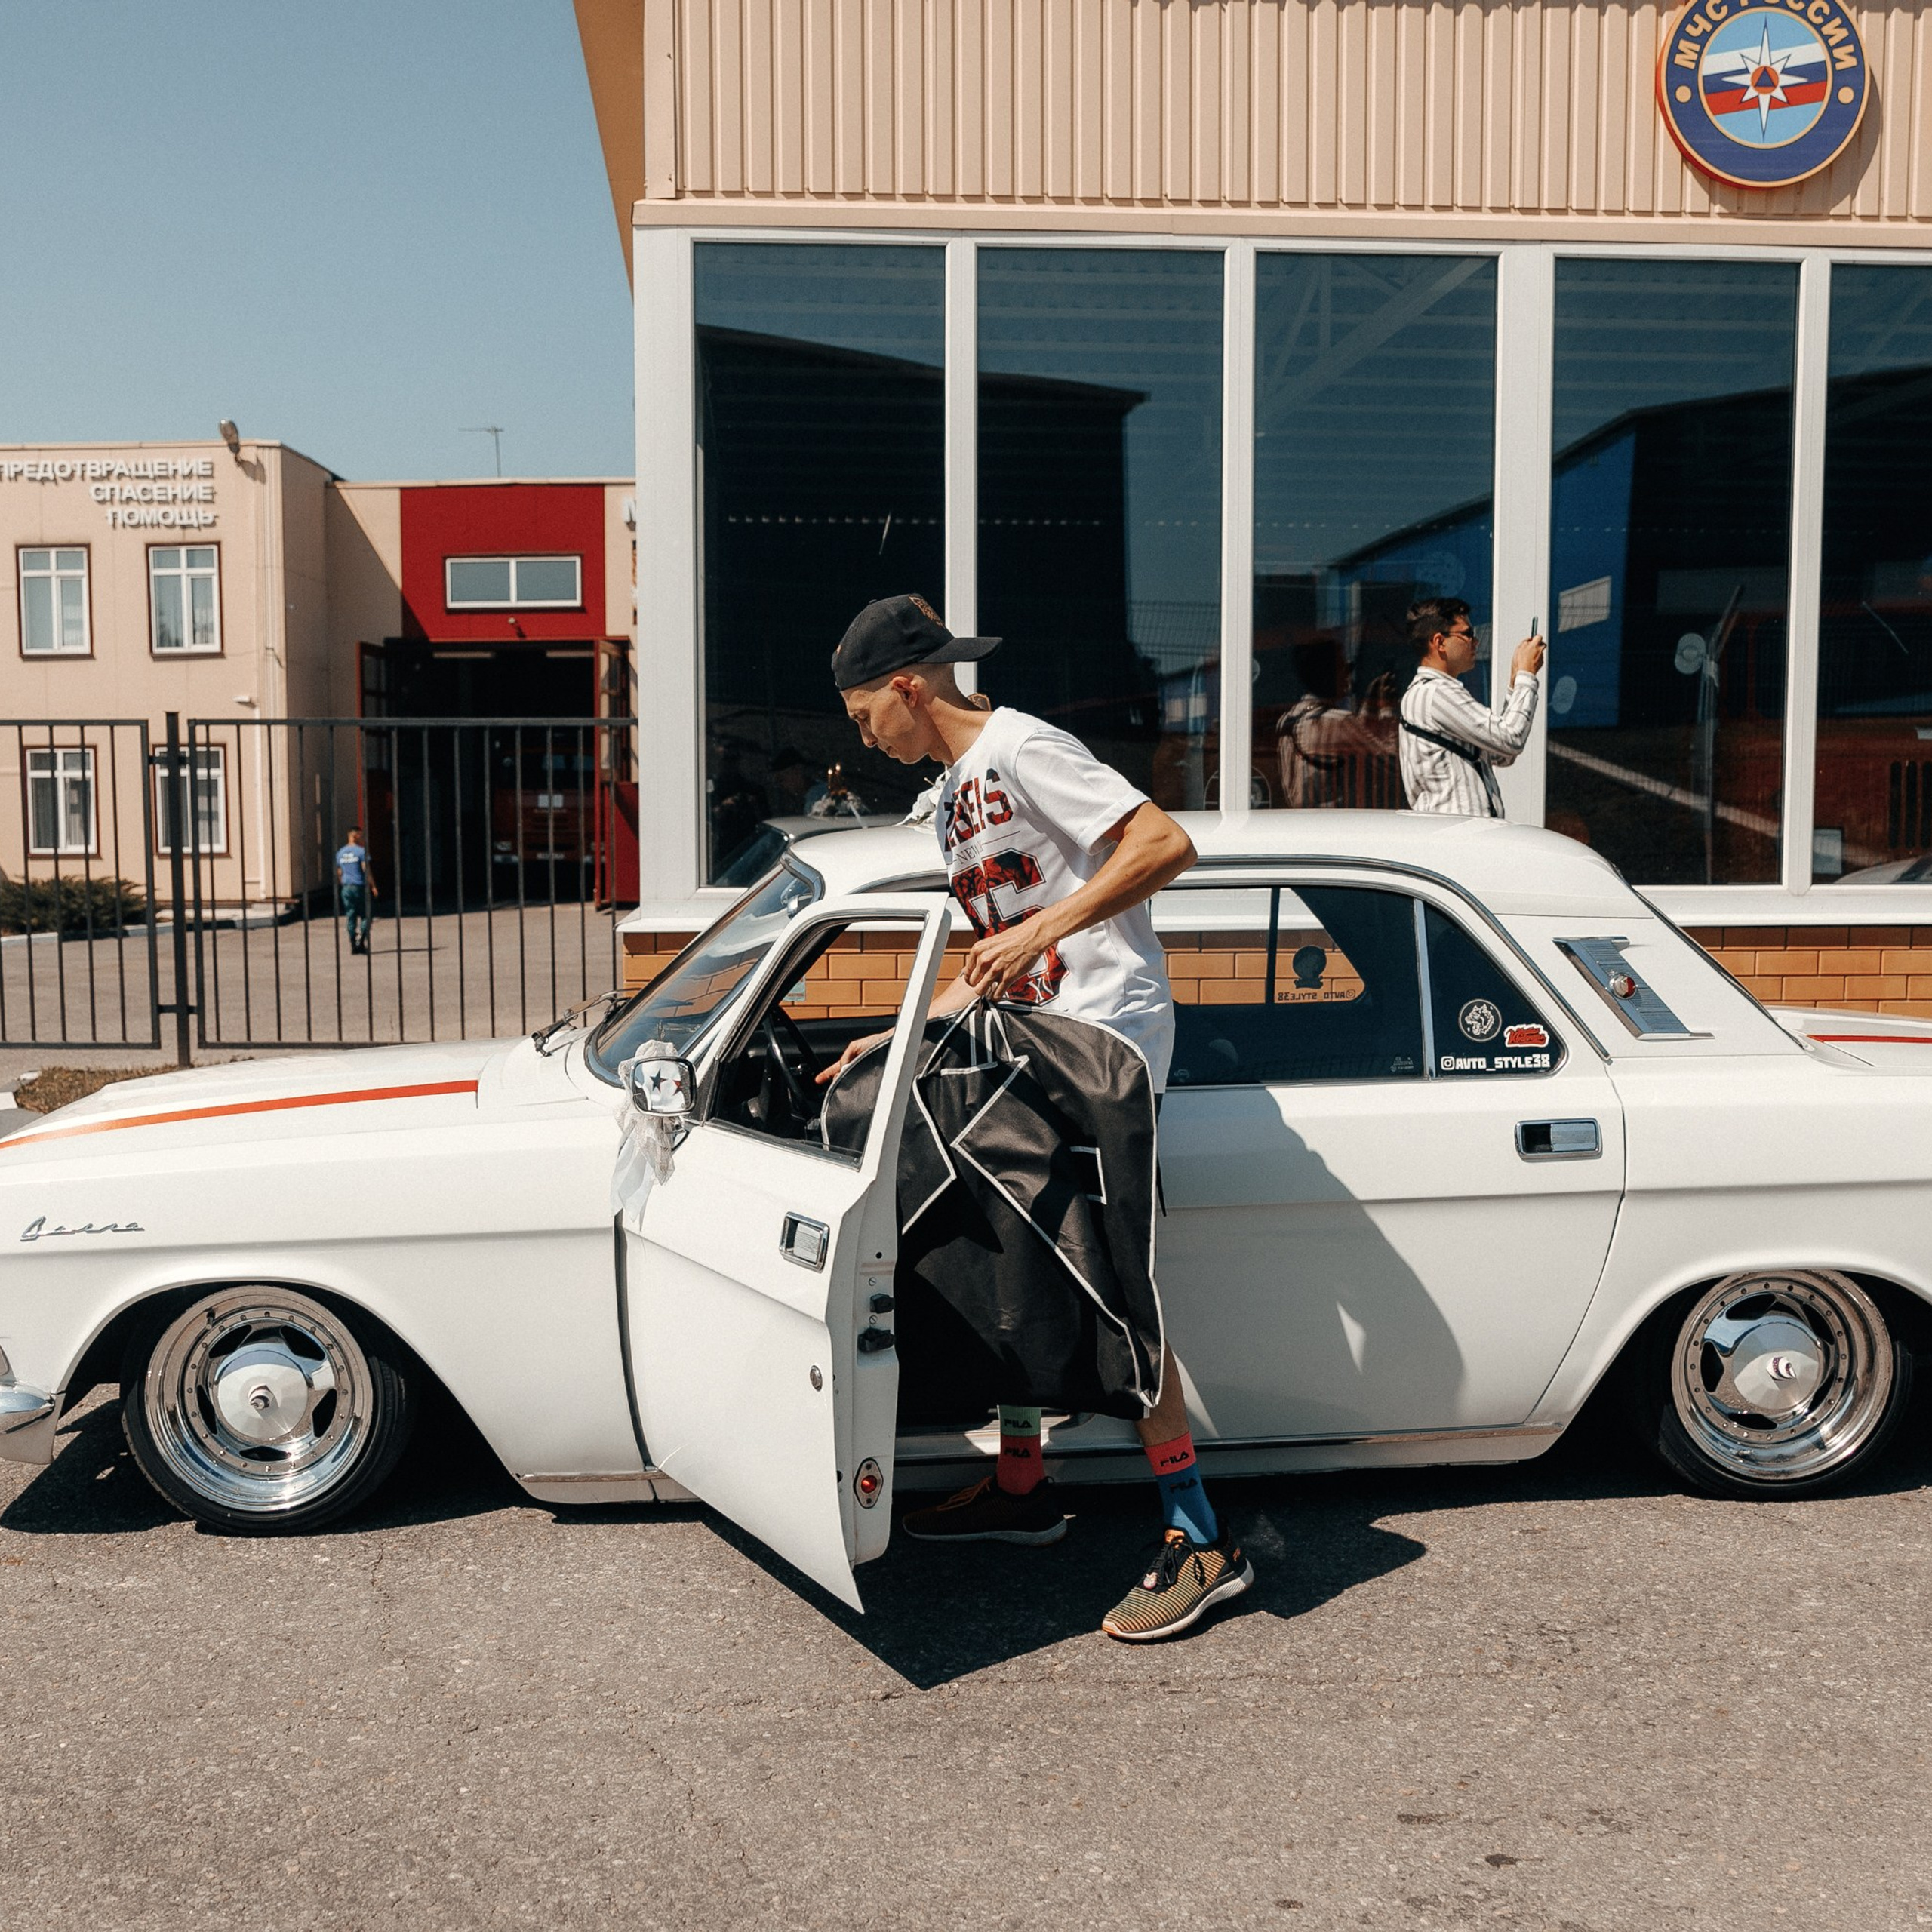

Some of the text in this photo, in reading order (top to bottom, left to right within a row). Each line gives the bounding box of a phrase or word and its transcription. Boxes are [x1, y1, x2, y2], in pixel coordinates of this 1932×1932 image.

[1674, 0, 1728, 70] МЧС
[89, 484, 214, 502] СПАСЕНИЕ
[106, 507, 214, 527] ПОМОЩЬ
[1004, 1418, 1032, 1429] FILA
[1004, 1447, 1031, 1458] FILA
[1160, 1451, 1189, 1467] FILA
[1170, 1478, 1198, 1494] FILA
